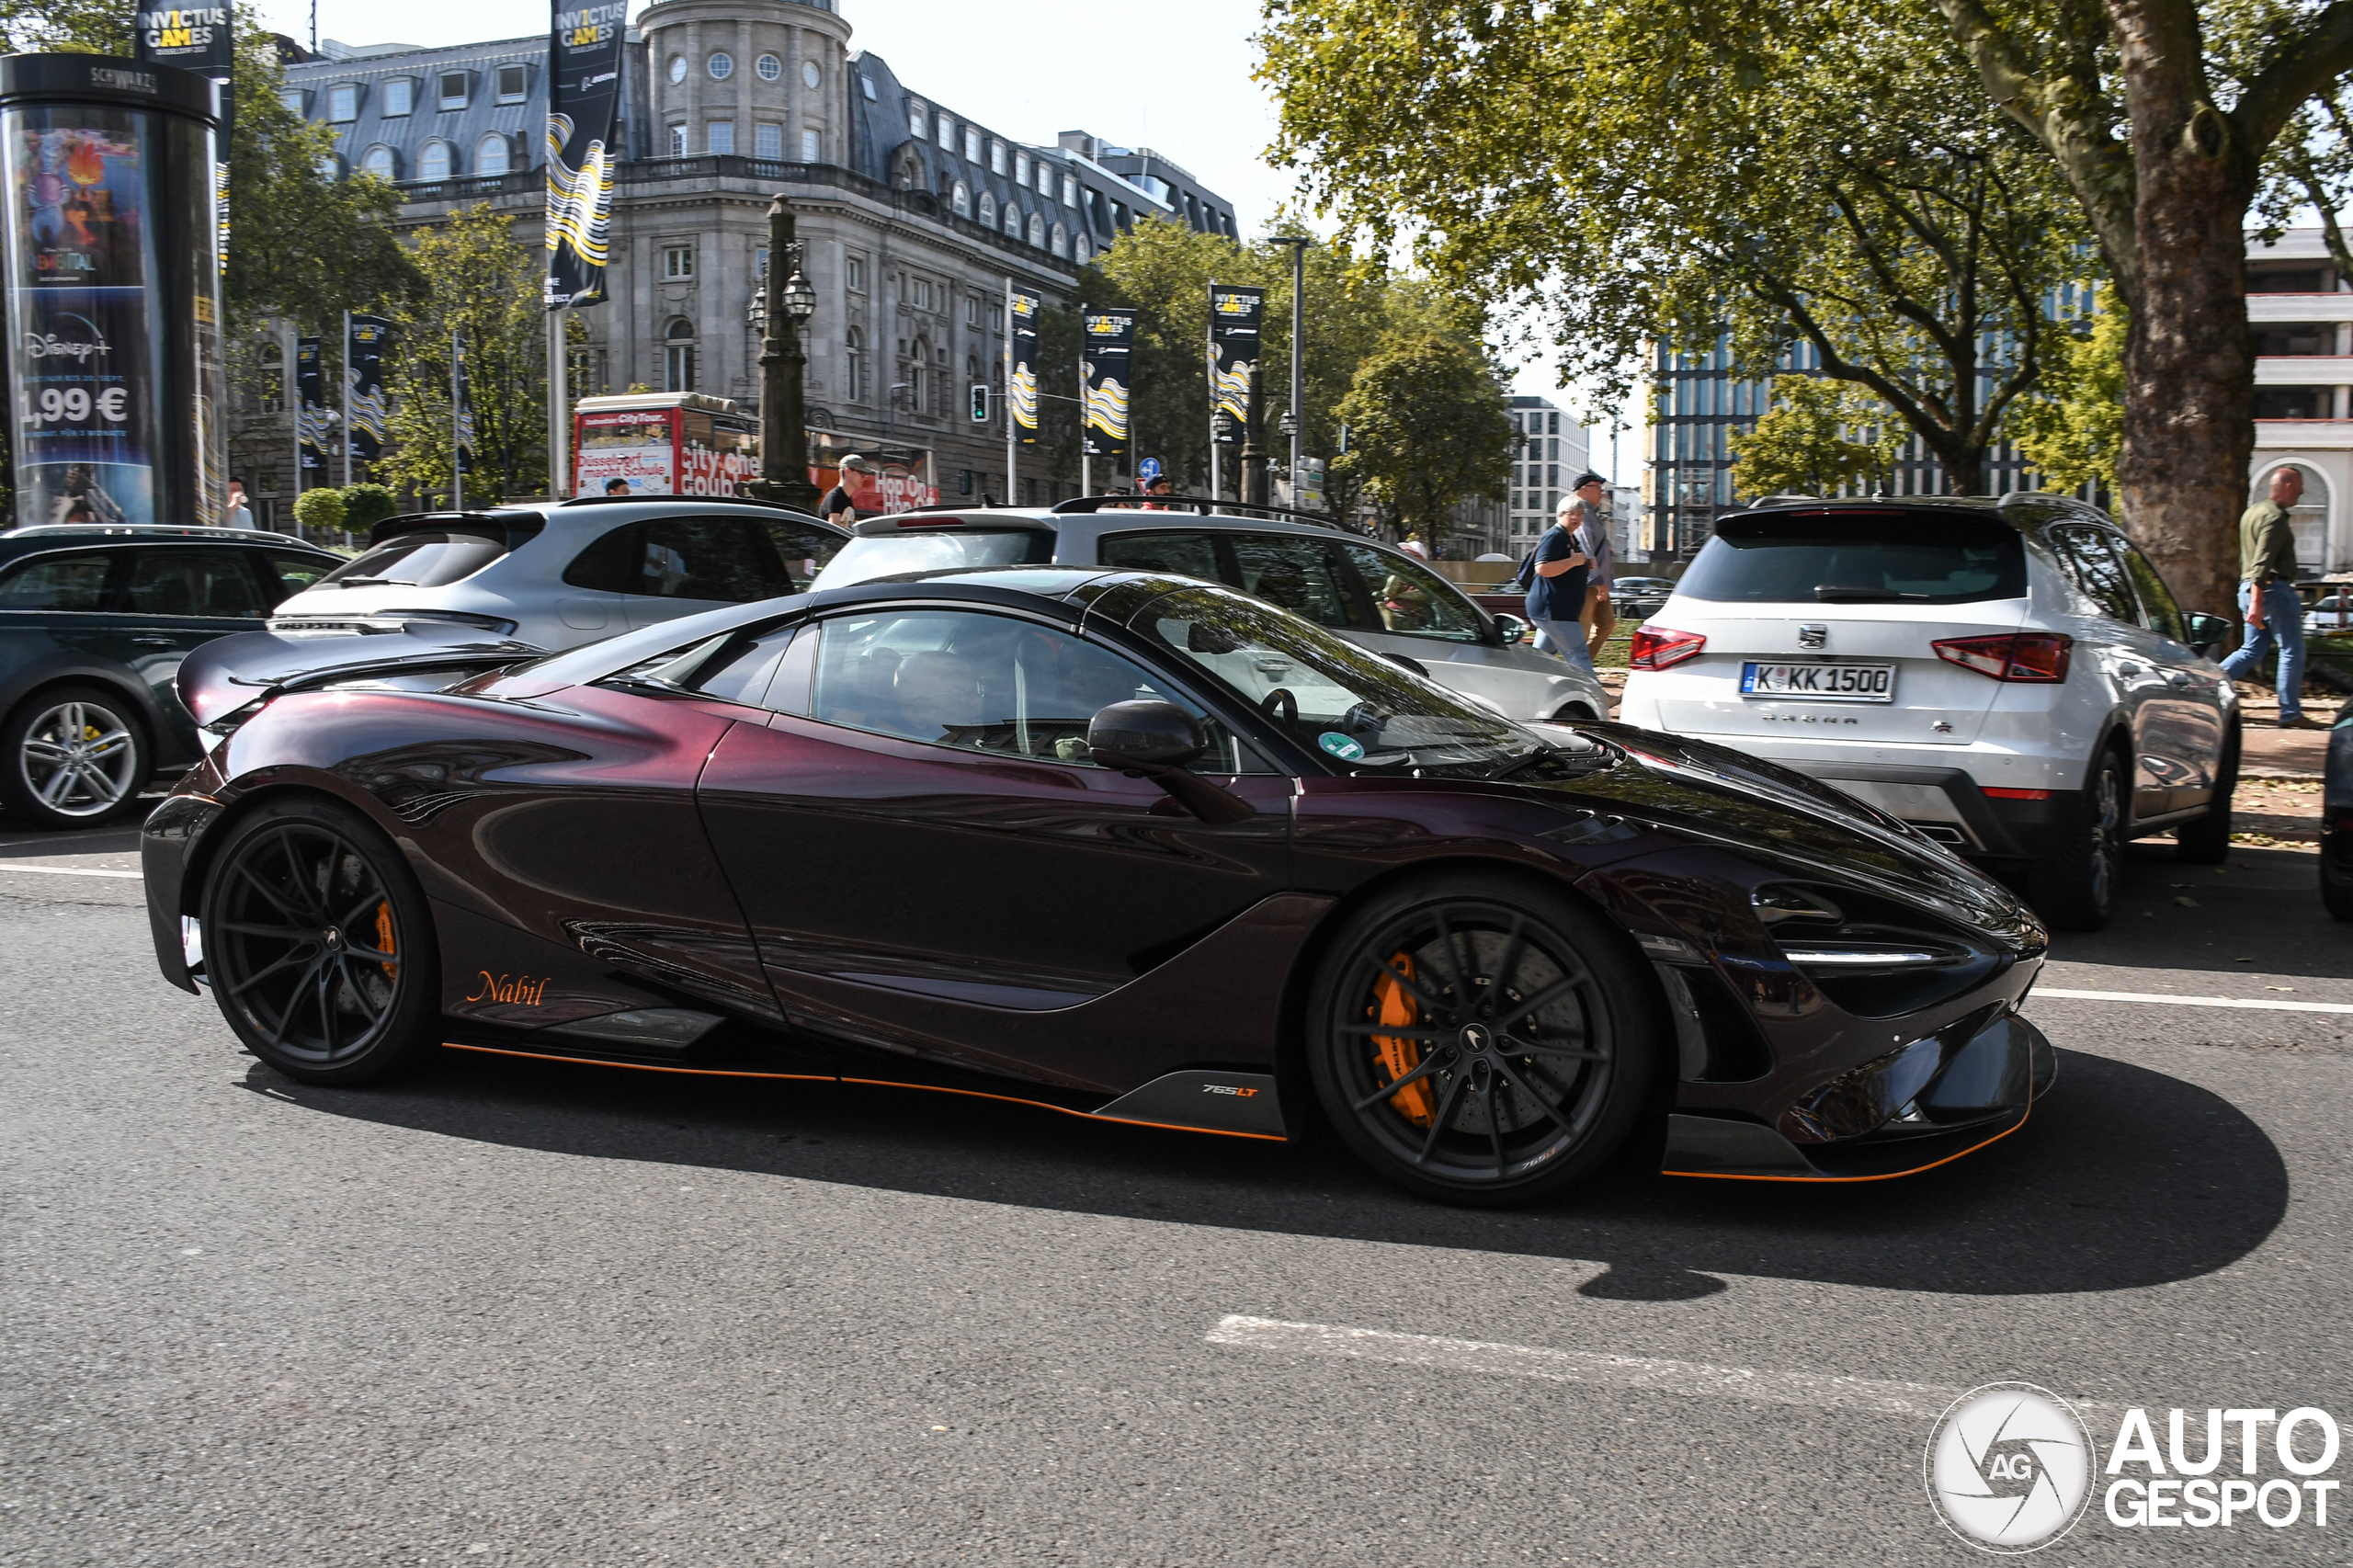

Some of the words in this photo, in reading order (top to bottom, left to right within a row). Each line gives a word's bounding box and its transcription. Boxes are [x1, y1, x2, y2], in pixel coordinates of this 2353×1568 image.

[137, 7, 228, 28] INVICTUS
[554, 1, 625, 29] INVICTUS
[144, 26, 214, 48] GAMES
[561, 22, 614, 47] GAMES
[1215, 302, 1252, 312] GAMES
[1086, 324, 1124, 333] GAMES
[19, 388, 91, 429] 1,99
[96, 387, 129, 422] €
[584, 463, 620, 477] macht
[624, 463, 665, 475] Schule
[682, 438, 721, 478] city
[724, 446, 762, 477] che
[680, 467, 739, 496] doub
[874, 471, 904, 497] Hop
[1757, 666, 1775, 690] K
[1789, 667, 1822, 691] KK
[1825, 669, 1889, 692] 1500
[466, 971, 551, 1006] Nabil
[1202, 1085, 1258, 1096] 765LT
